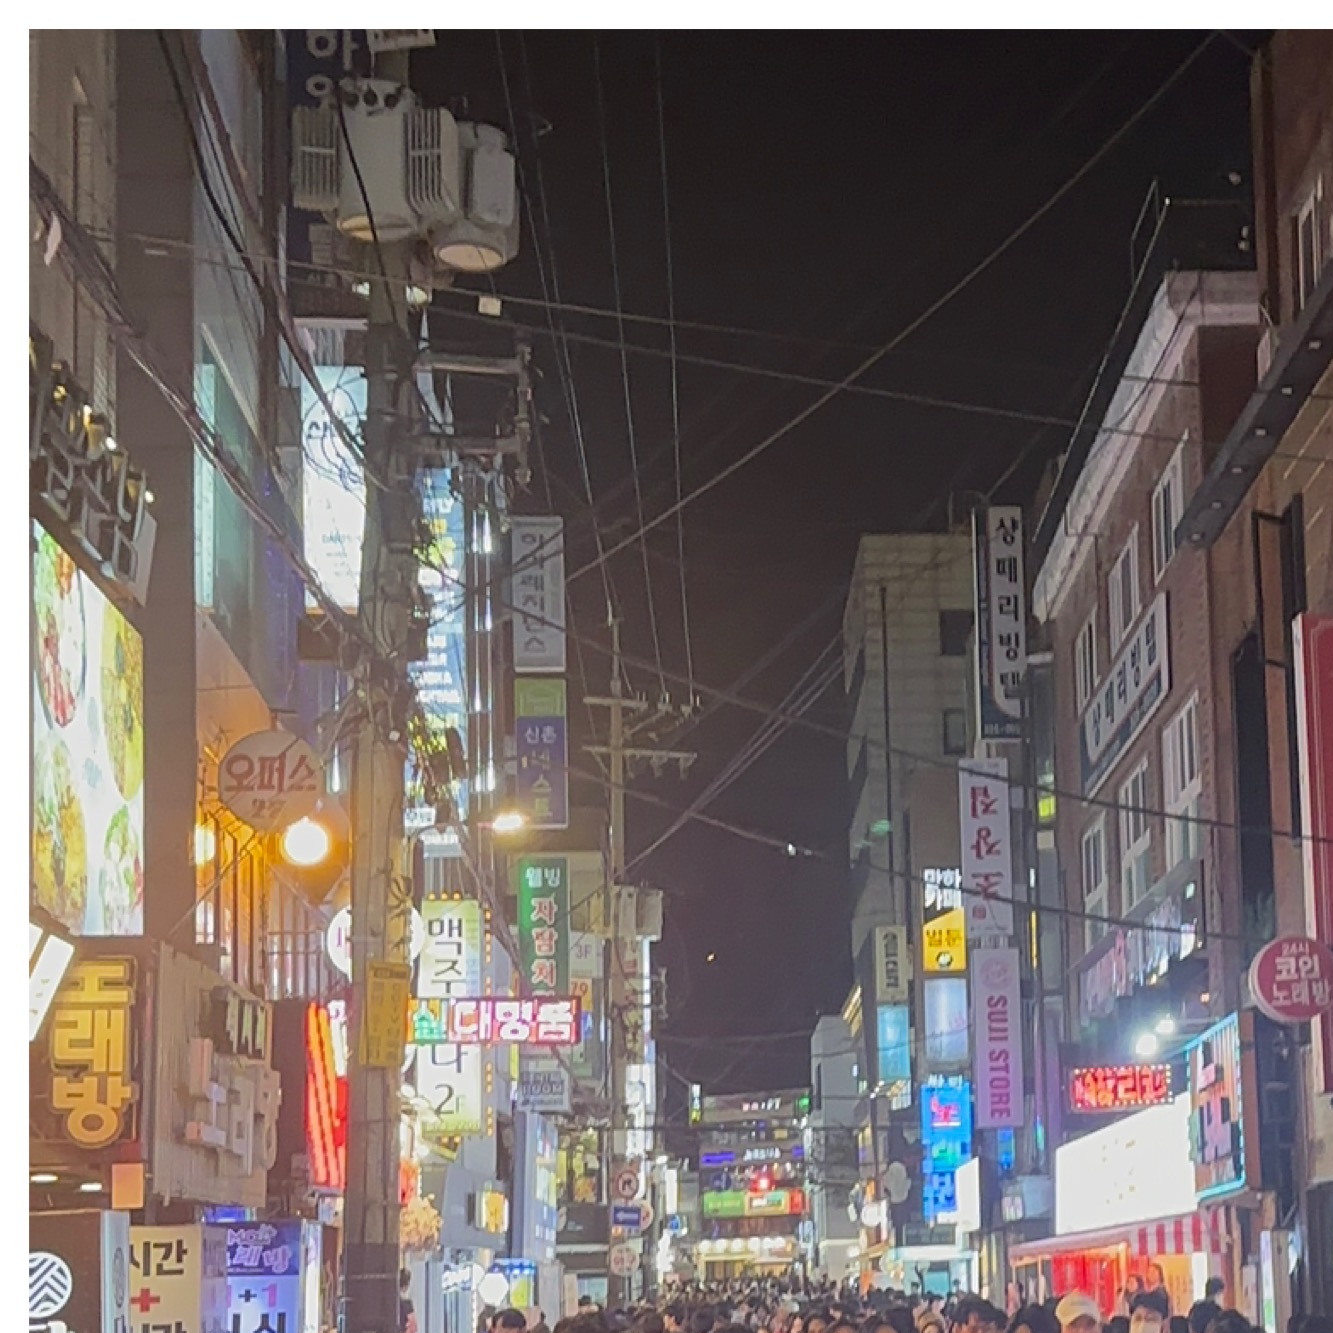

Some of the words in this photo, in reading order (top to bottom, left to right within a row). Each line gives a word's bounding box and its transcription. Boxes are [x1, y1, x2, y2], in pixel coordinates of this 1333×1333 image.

[224, 753, 317, 793] 오퍼스
[530, 896, 559, 996] 자담치
[1274, 954, 1322, 982] 코인
[986, 994, 1009, 1042] SUJI
[988, 1049, 1012, 1119] STORE
